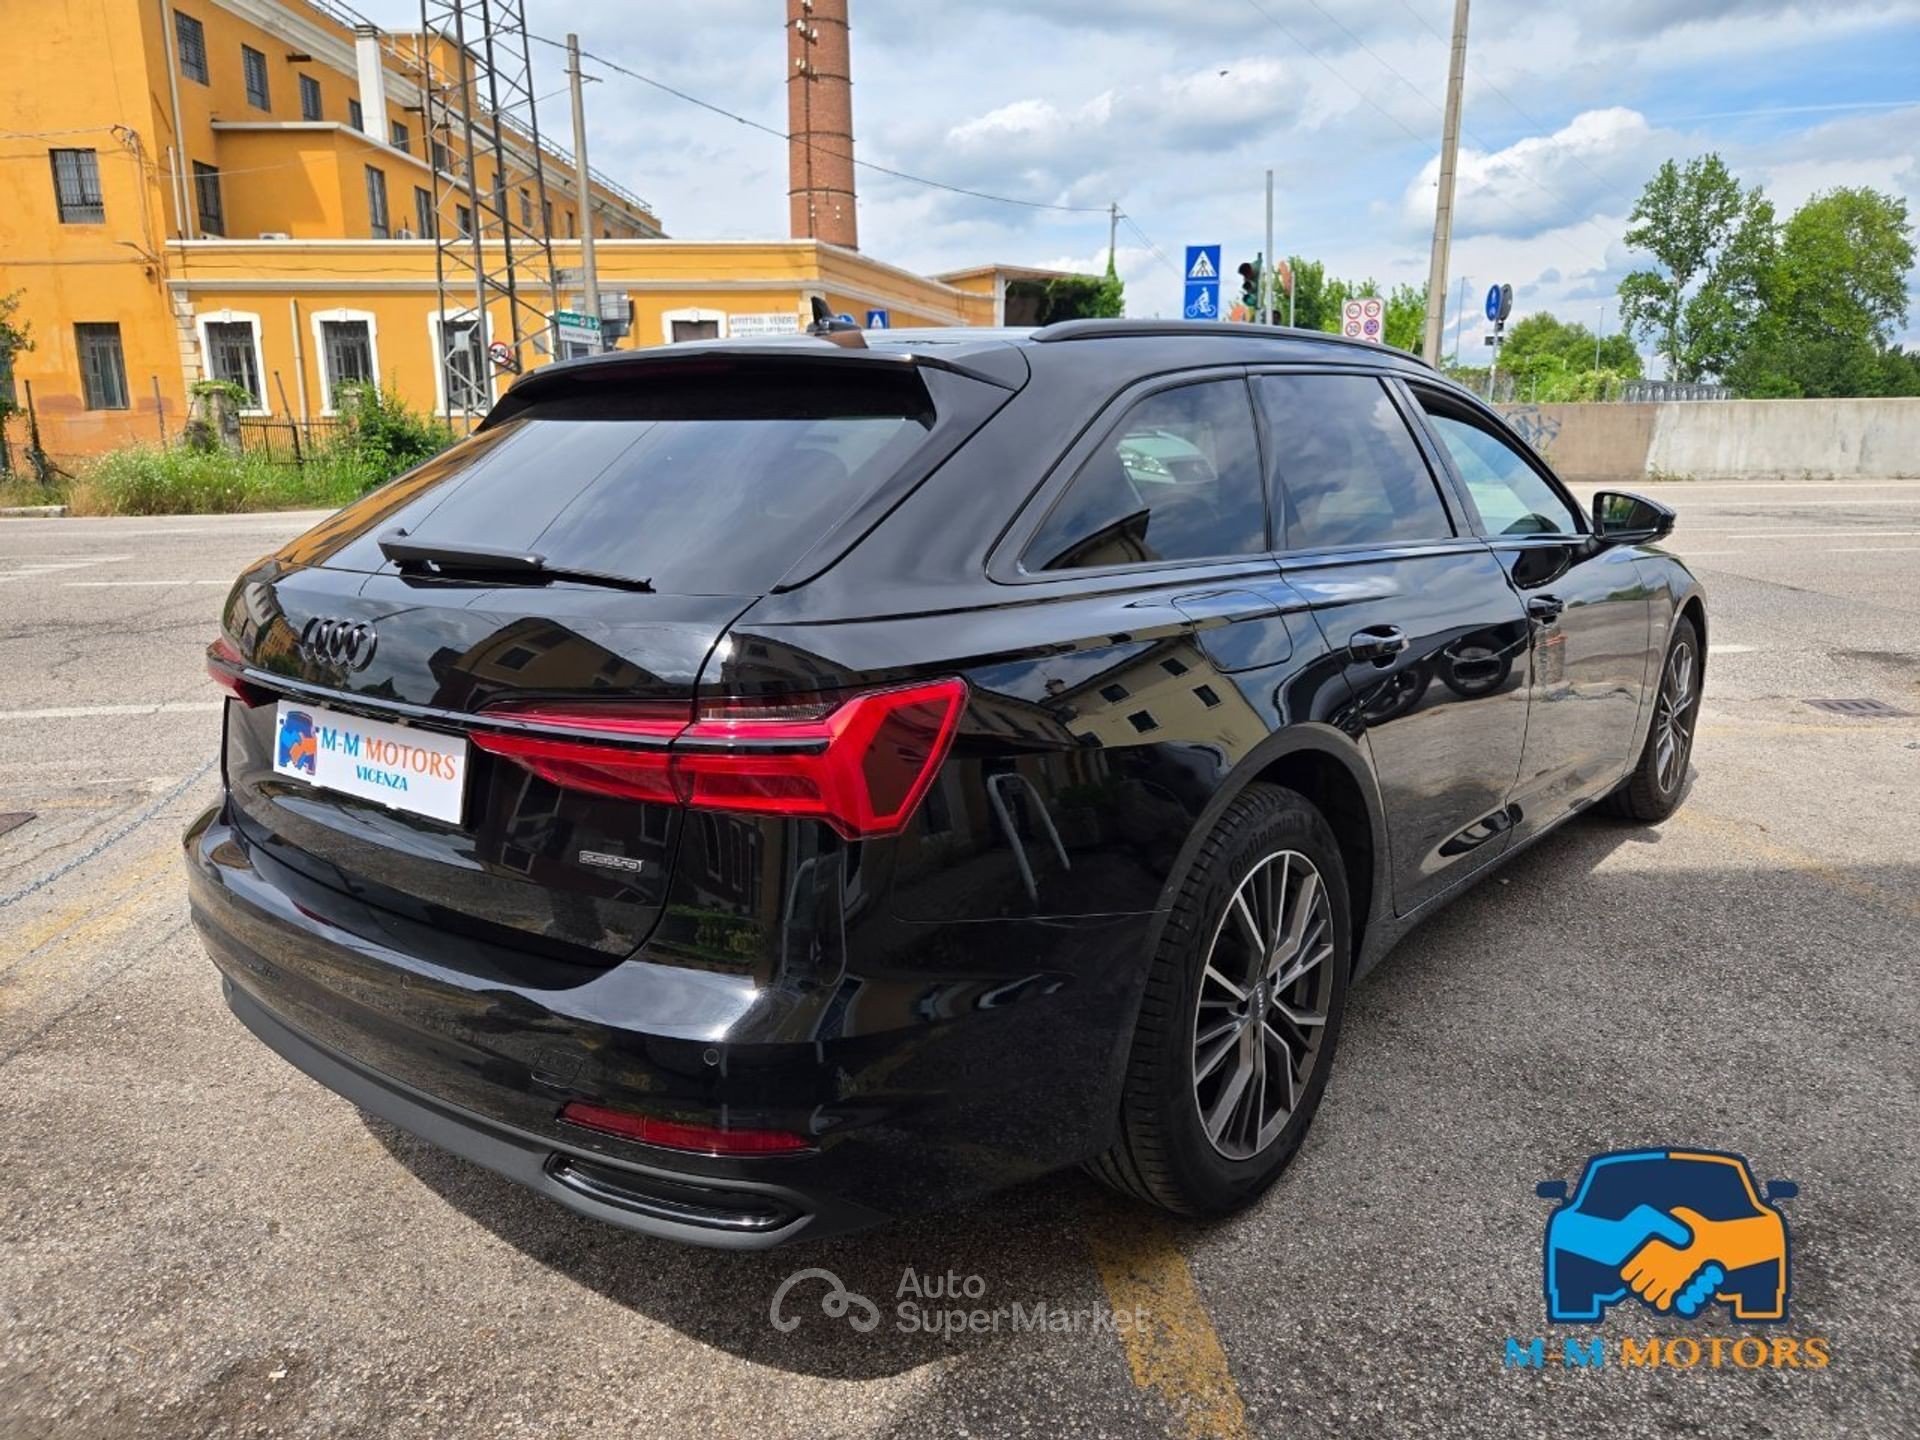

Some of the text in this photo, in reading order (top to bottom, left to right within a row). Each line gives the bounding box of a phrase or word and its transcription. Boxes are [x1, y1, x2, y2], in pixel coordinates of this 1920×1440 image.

[321, 726, 456, 781] M-M MOTORS
[356, 764, 408, 791] VICENZA
